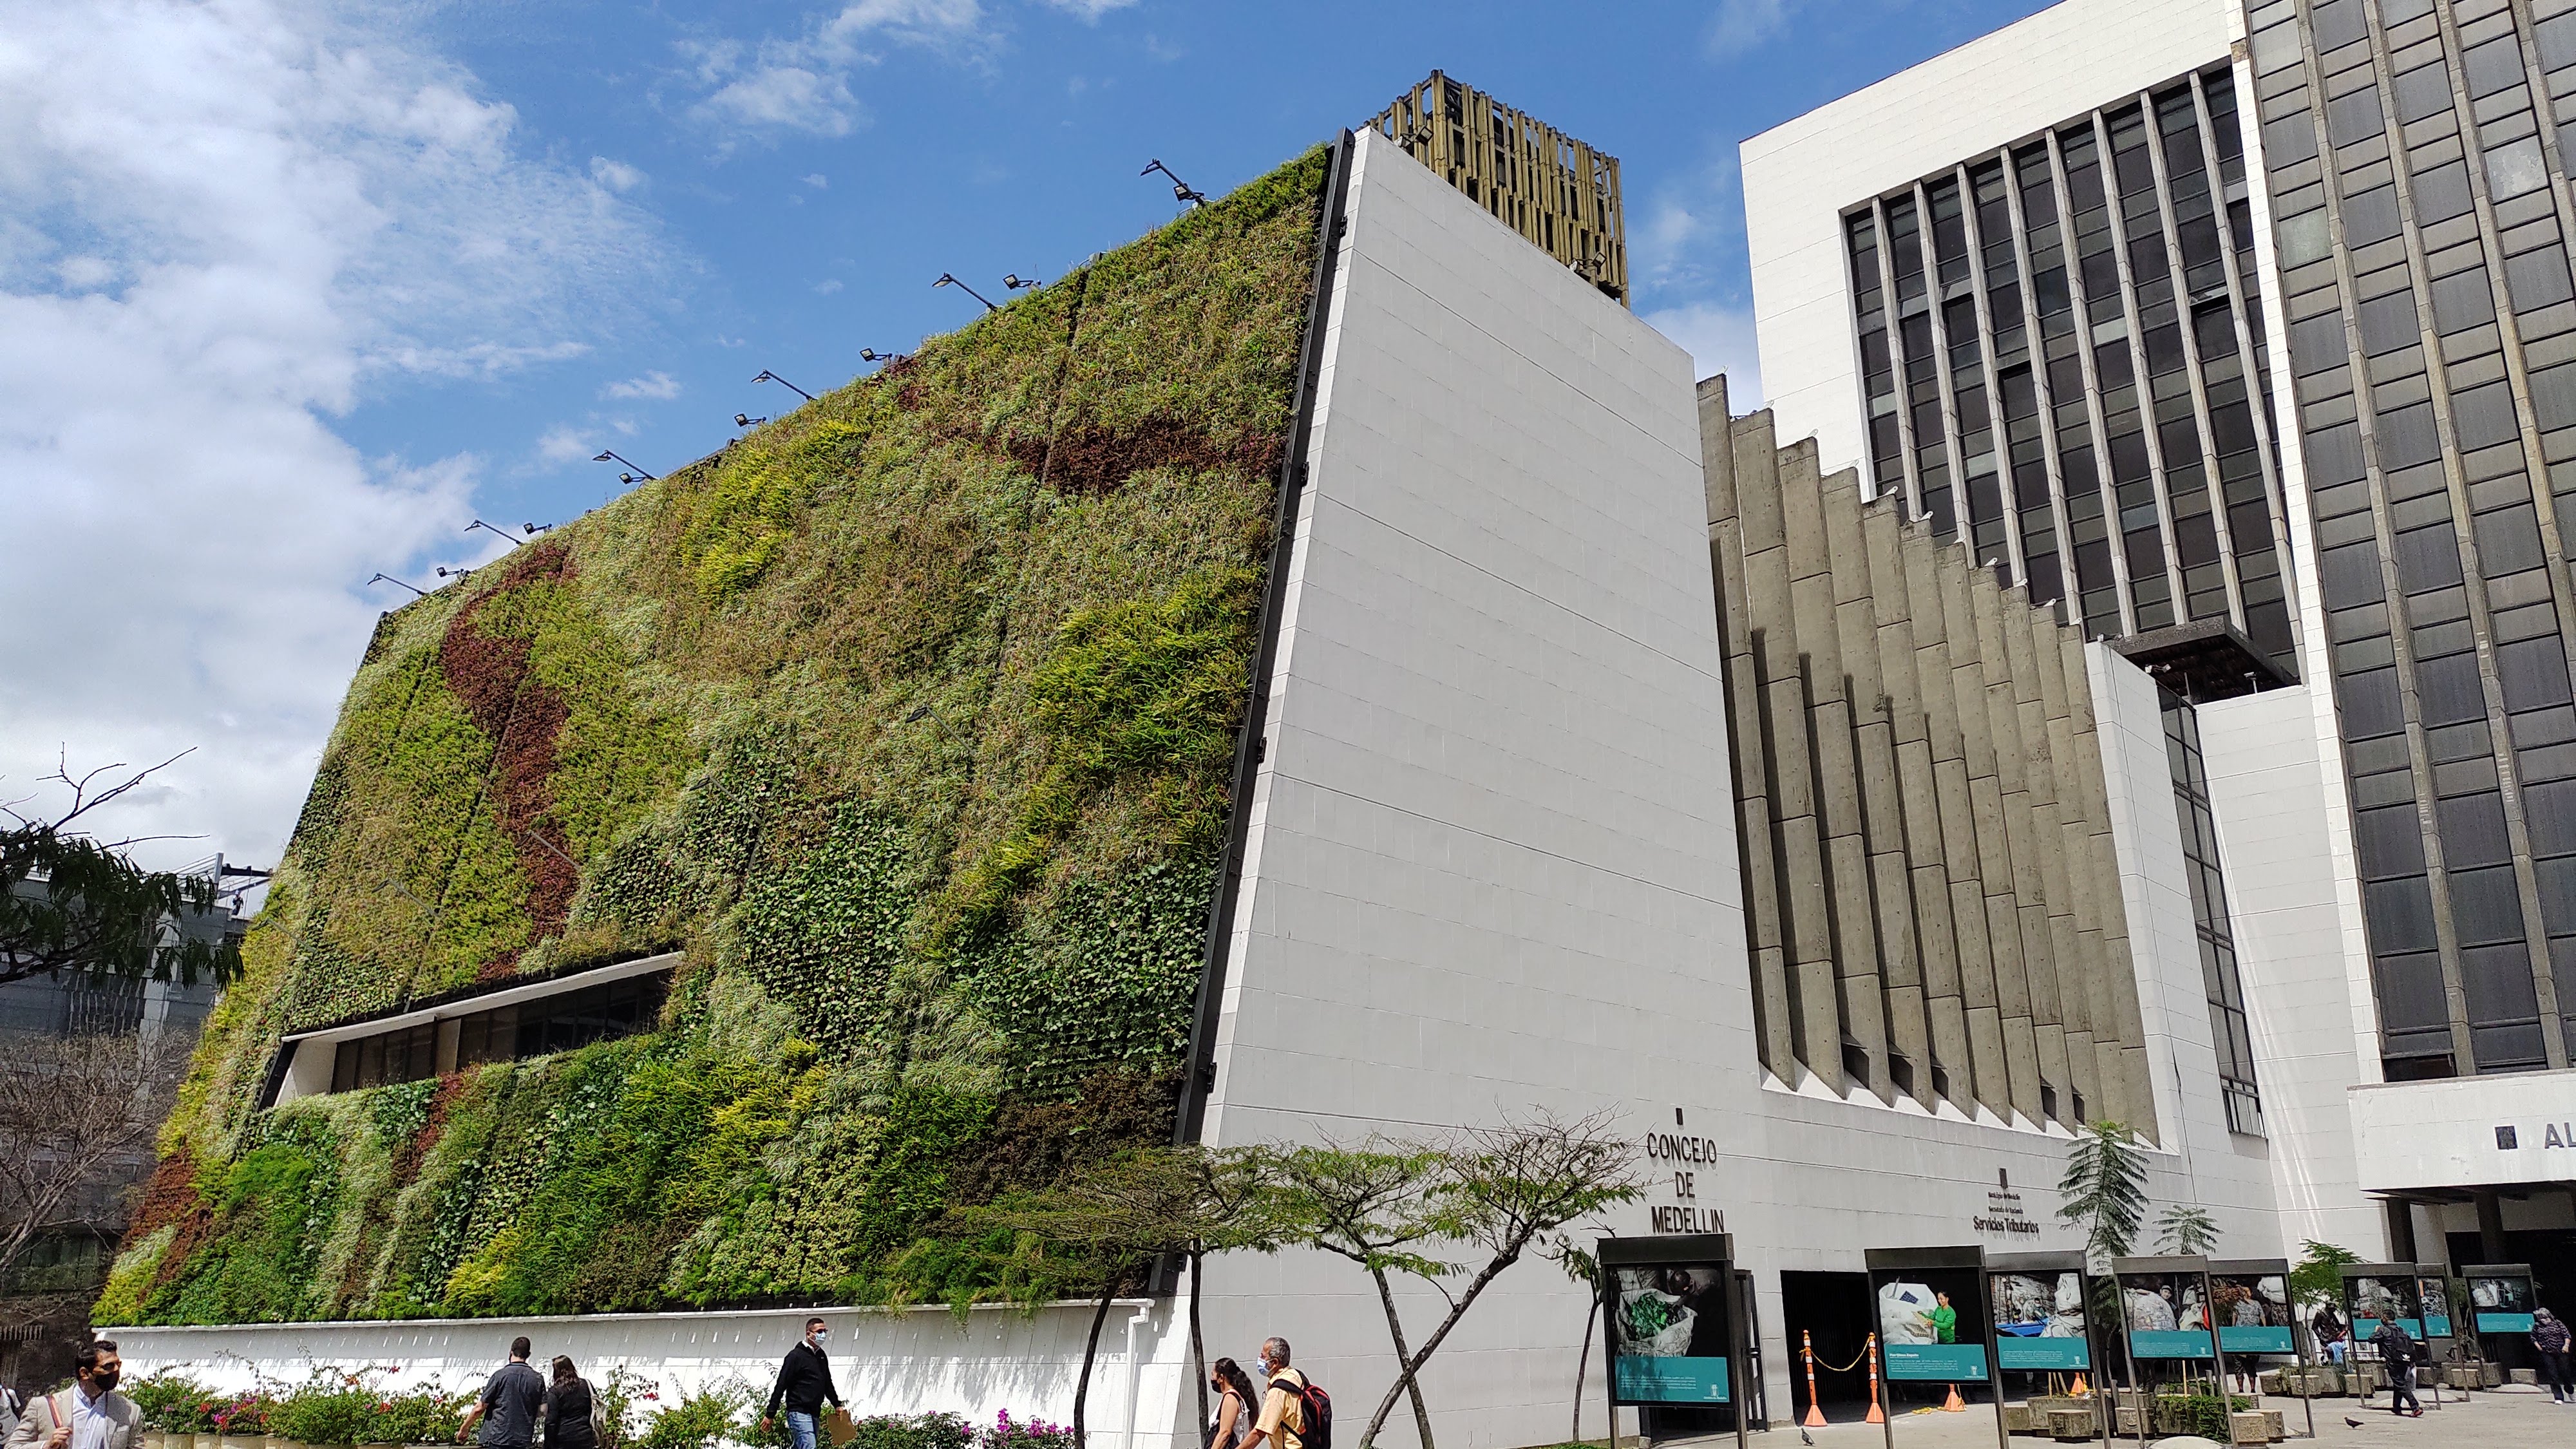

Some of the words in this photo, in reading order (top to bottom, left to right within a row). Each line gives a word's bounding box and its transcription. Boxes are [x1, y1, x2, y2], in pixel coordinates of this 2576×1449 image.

[1647, 1132, 1717, 1164] CONCEJO
[1675, 1171, 1696, 1198] DE
[1651, 1206, 1725, 1234] MEDELLIN
[1973, 1215, 2004, 1232] Servicios
[2004, 1218, 2039, 1233] Tributarios
